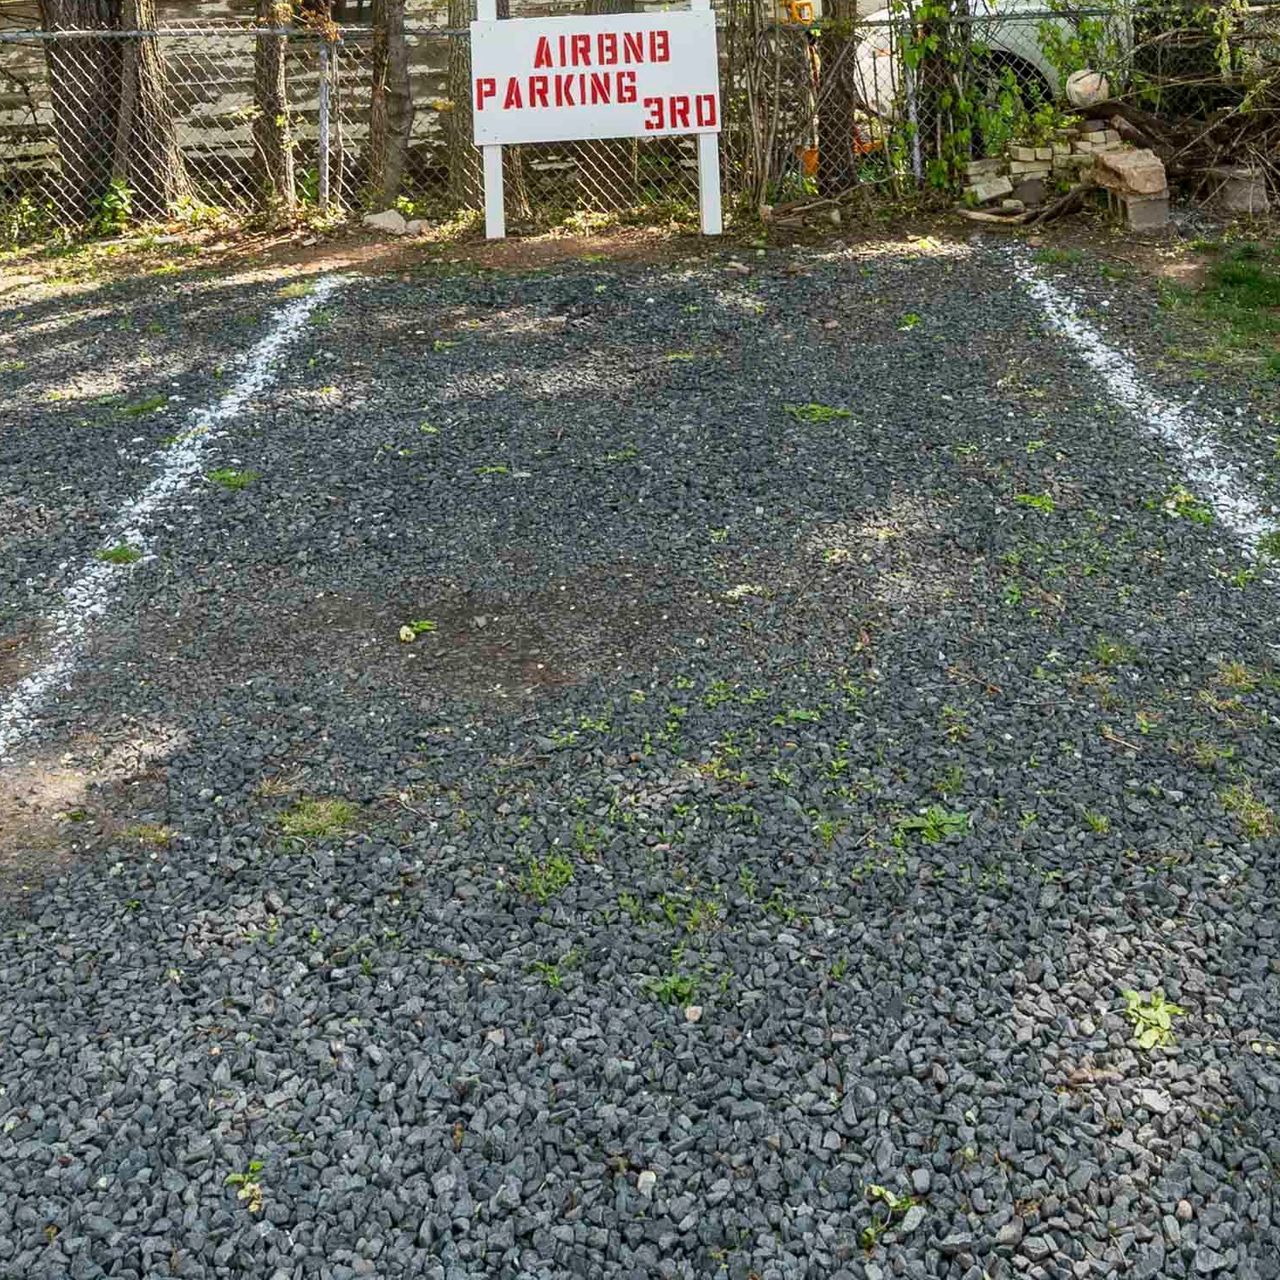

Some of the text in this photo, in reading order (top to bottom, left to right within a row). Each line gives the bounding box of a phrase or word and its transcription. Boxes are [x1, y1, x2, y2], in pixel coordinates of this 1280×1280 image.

[533, 30, 671, 69] AIRBNB
[475, 70, 638, 111] PARKING
[642, 94, 718, 130] 3RD
